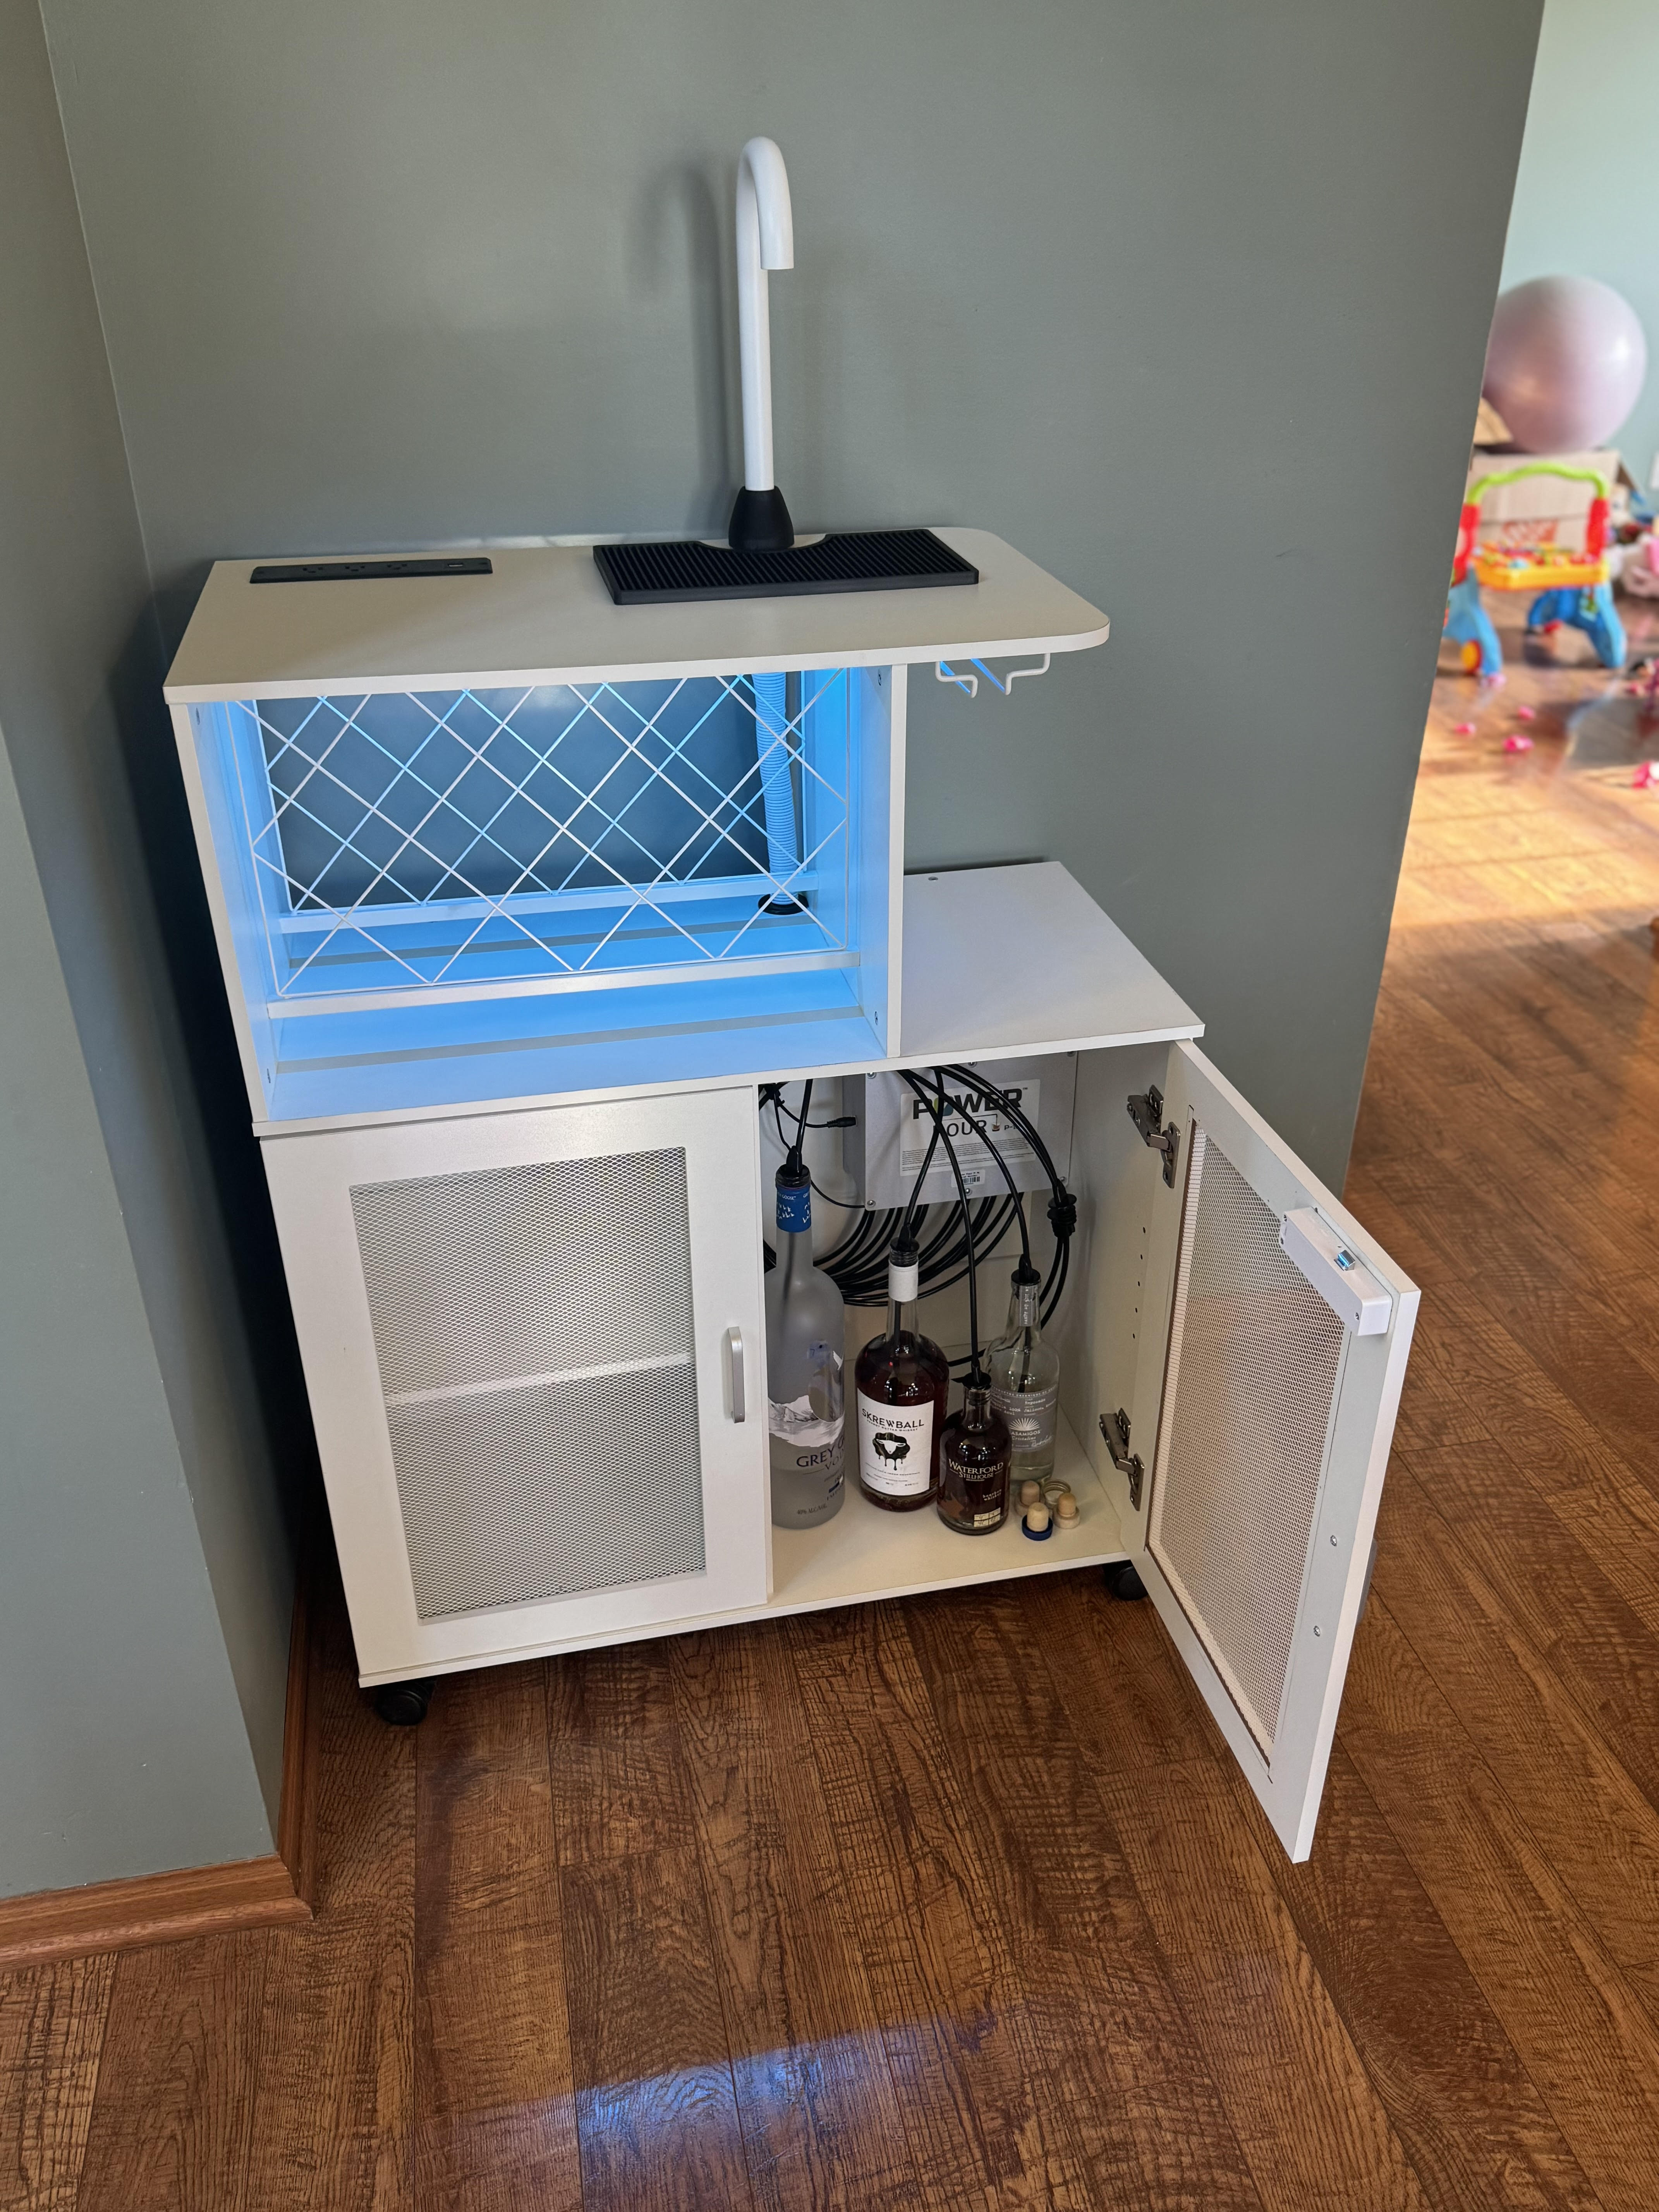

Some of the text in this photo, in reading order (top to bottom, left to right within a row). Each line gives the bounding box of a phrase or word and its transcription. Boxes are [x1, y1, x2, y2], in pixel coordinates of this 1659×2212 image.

[933, 1120, 987, 1137] OUR
[862, 1408, 924, 1428] SKREWBALL
[796, 1445, 835, 1467] GREY
[949, 1458, 1003, 1475] WATERFORD
